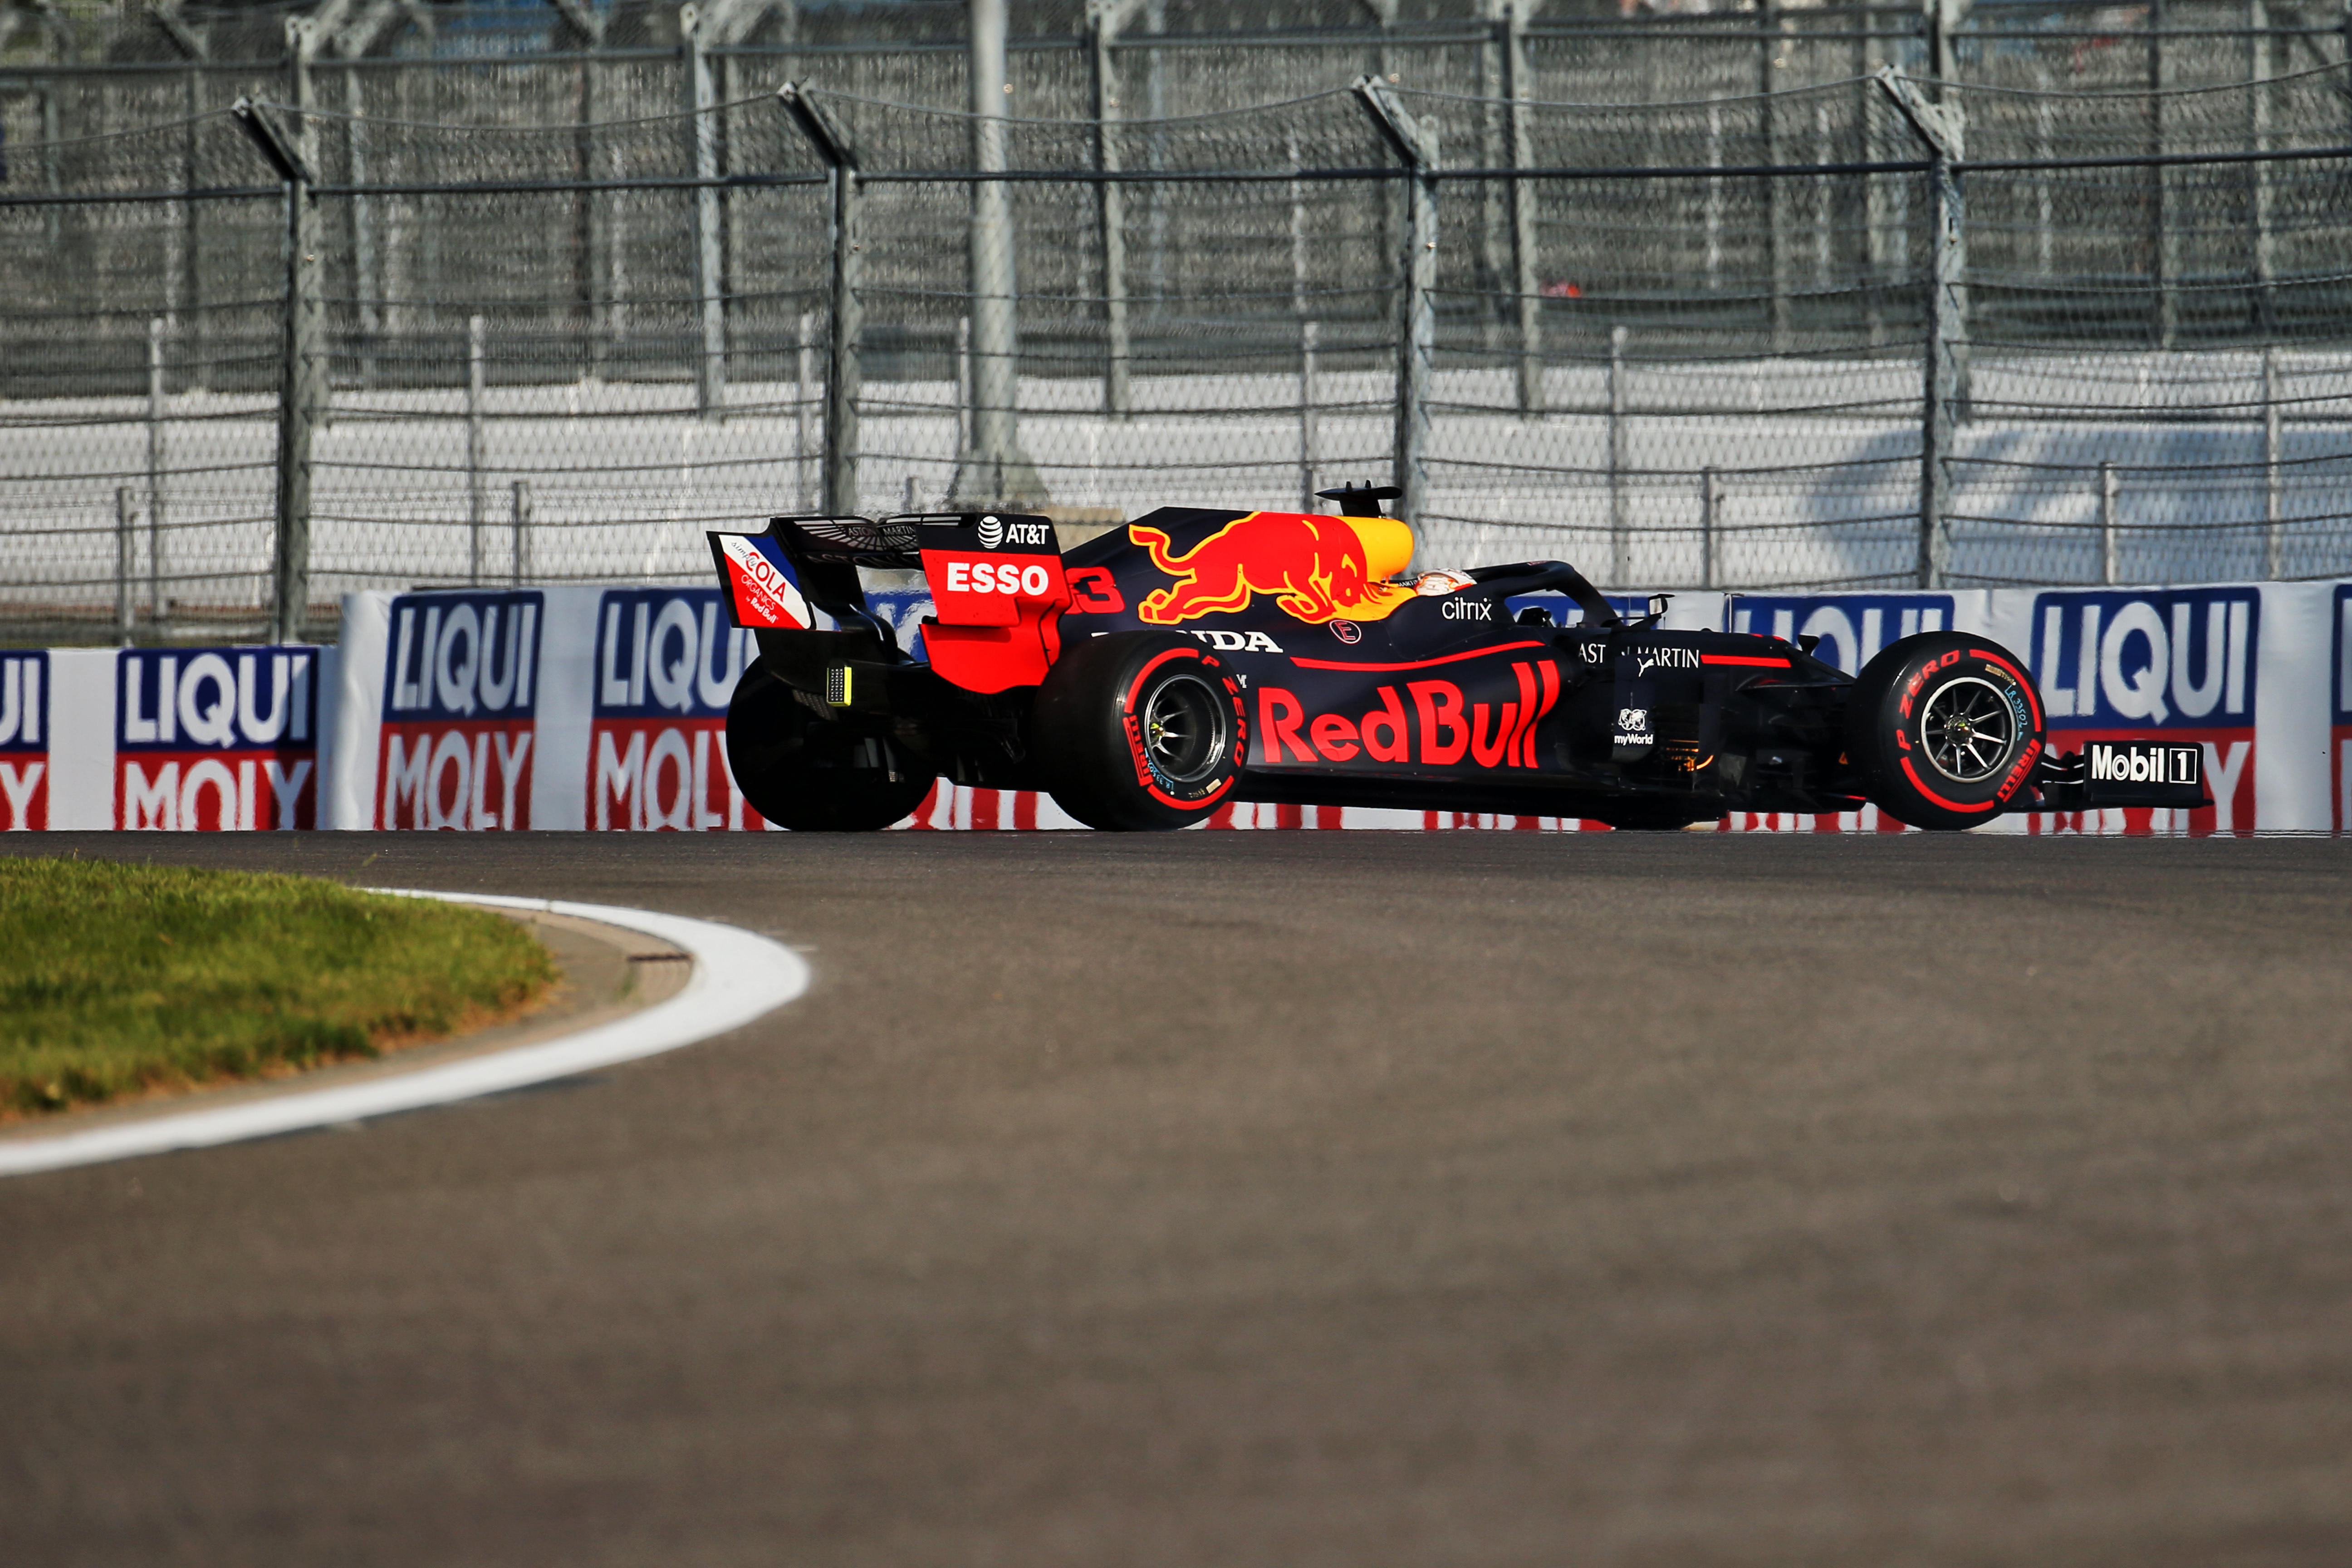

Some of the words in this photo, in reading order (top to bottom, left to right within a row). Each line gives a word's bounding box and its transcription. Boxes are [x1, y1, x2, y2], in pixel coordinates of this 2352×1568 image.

[731, 541, 758, 567] simply
[1006, 524, 1049, 544] AT&T
[741, 574, 776, 610] ORGANICS
[746, 552, 785, 603] COLA
[947, 562, 1049, 595] ESSO
[750, 597, 764, 612] Red
[762, 605, 777, 624] Bull
[1335, 622, 1356, 640] E
[1442, 597, 1492, 621] citrix
[392, 602, 536, 717] LIQUI
[600, 597, 760, 715] LIQU
[2043, 601, 2250, 725] LIQUI
[124, 652, 310, 749] LIQUI
[1899, 650, 1960, 719] ZERO
[1201, 655, 1220, 667] P
[1222, 676, 1247, 767] ZERO
[1258, 686, 1409, 763] Red
[1406, 659, 1561, 769] Bull
[1122, 715, 1155, 787] PIRELLI
[1614, 733, 1654, 746] myWorld
[1896, 729, 1911, 751] P
[2092, 745, 2165, 782] Mobil
[2177, 751, 2187, 780] 1
[385, 731, 534, 830] MOLY
[1997, 738, 2042, 803] PIRELLI
